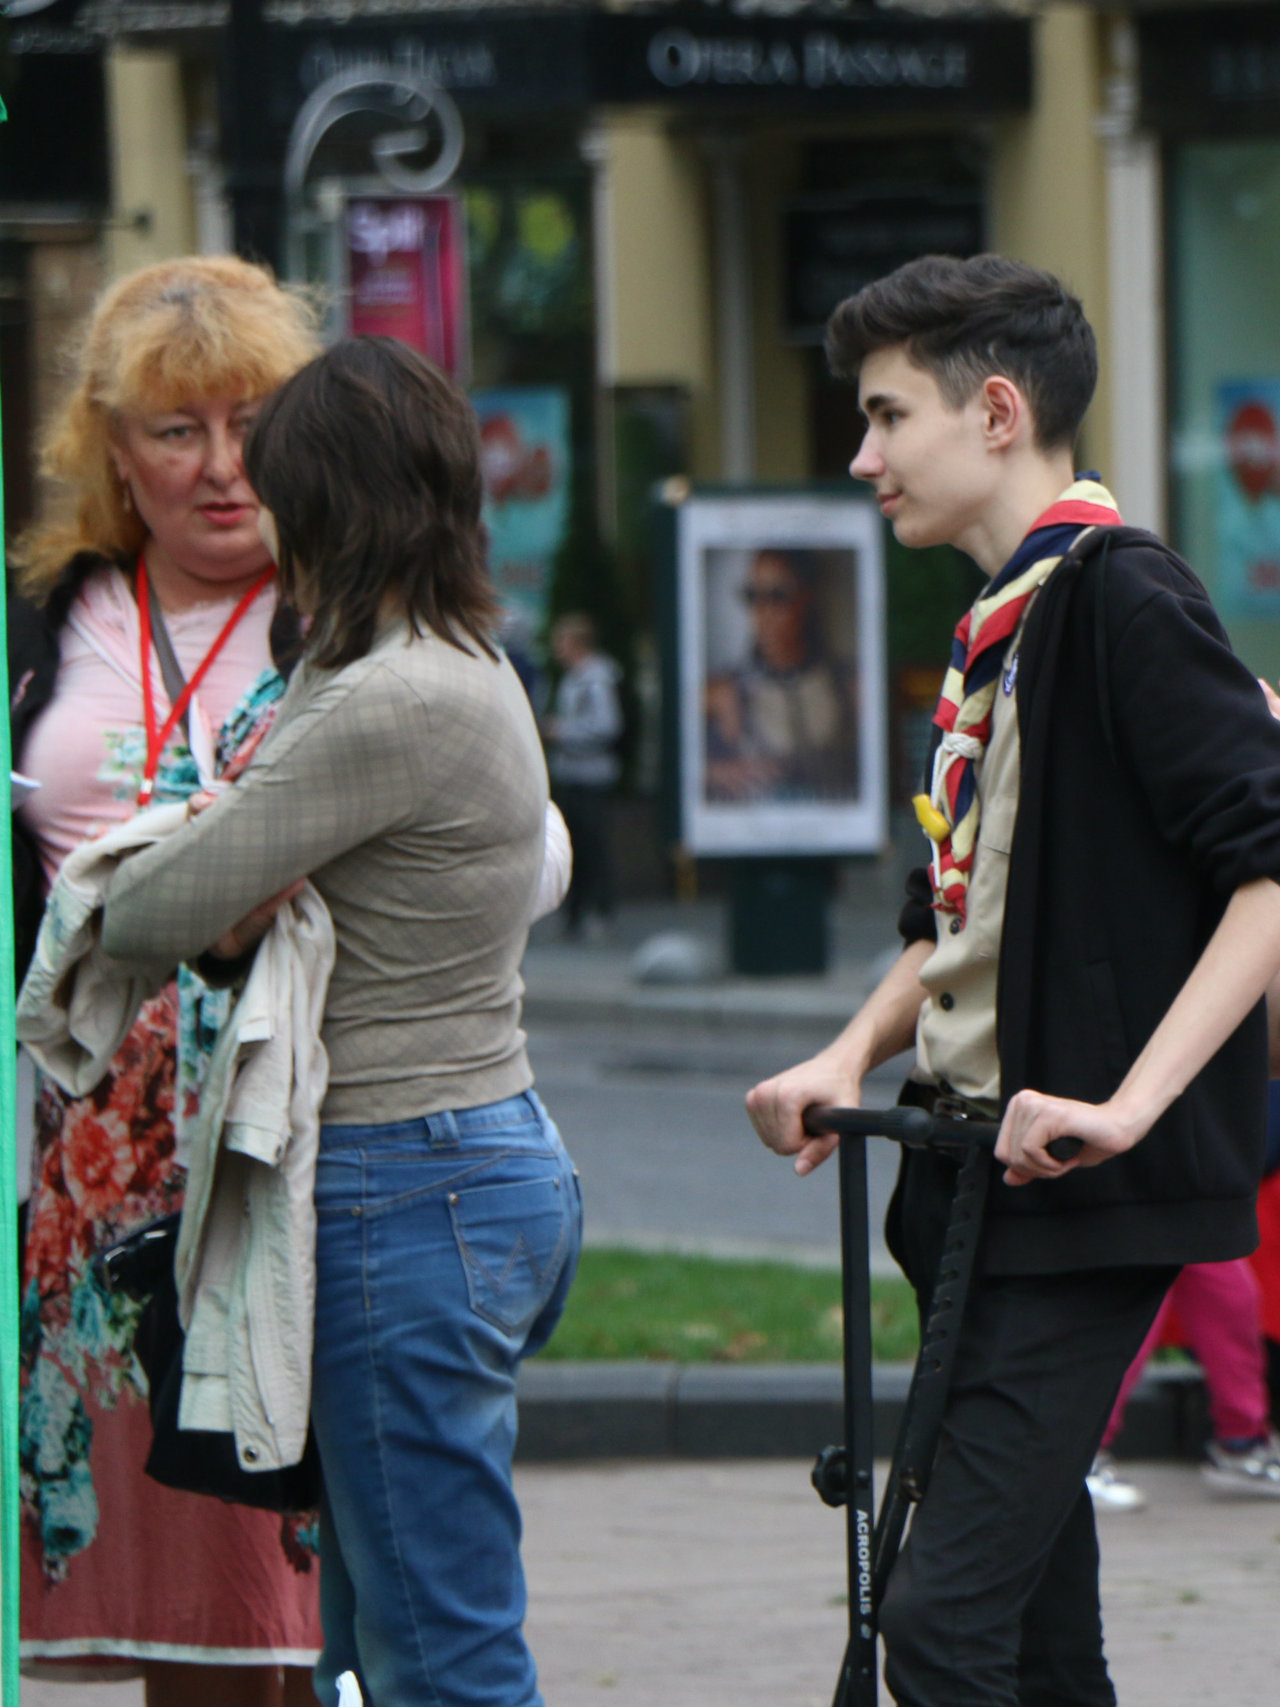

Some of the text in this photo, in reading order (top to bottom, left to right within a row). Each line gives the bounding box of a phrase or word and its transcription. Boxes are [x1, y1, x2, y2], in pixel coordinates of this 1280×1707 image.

[648, 29, 968, 88] OPERA PASSAGE
[856, 1509, 872, 1615] ACROPOLIS
